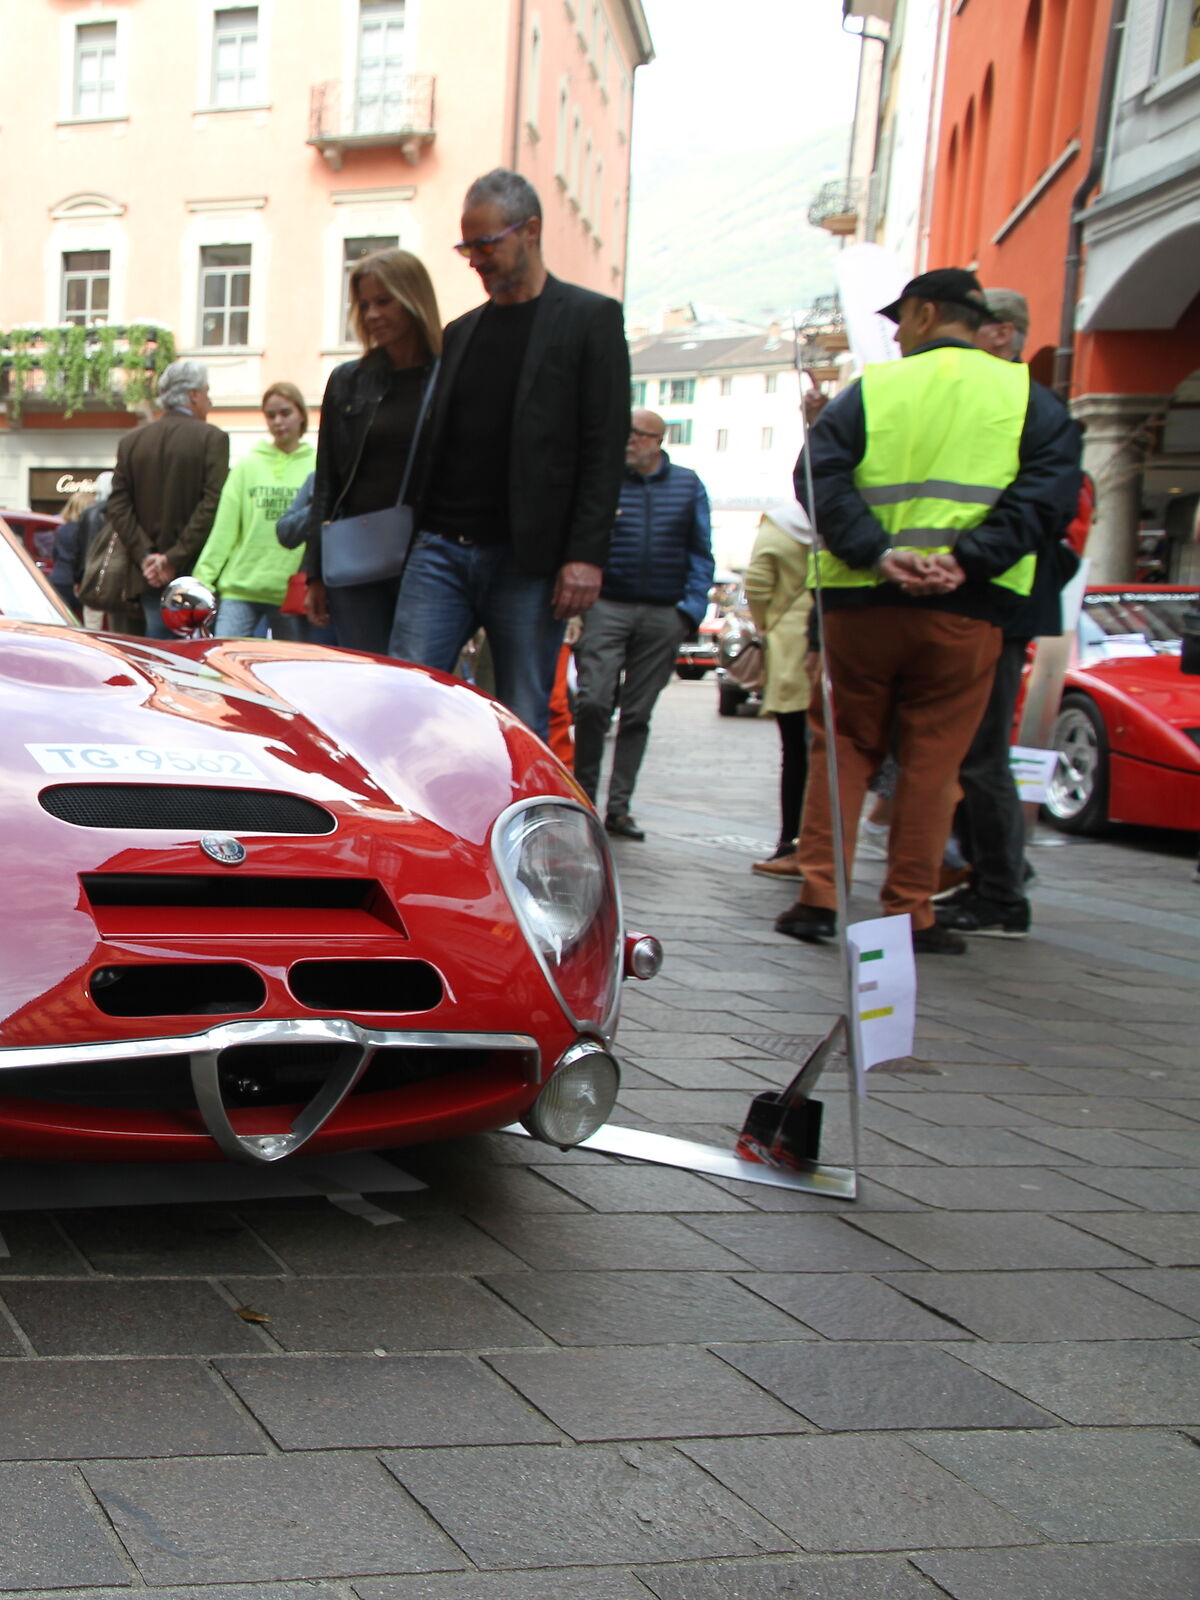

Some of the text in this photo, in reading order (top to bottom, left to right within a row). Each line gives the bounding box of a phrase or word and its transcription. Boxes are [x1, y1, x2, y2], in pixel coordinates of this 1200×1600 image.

[248, 486, 302, 499] VETEMENT
[256, 498, 294, 512] LIMITE
[135, 750, 252, 775] 9562
